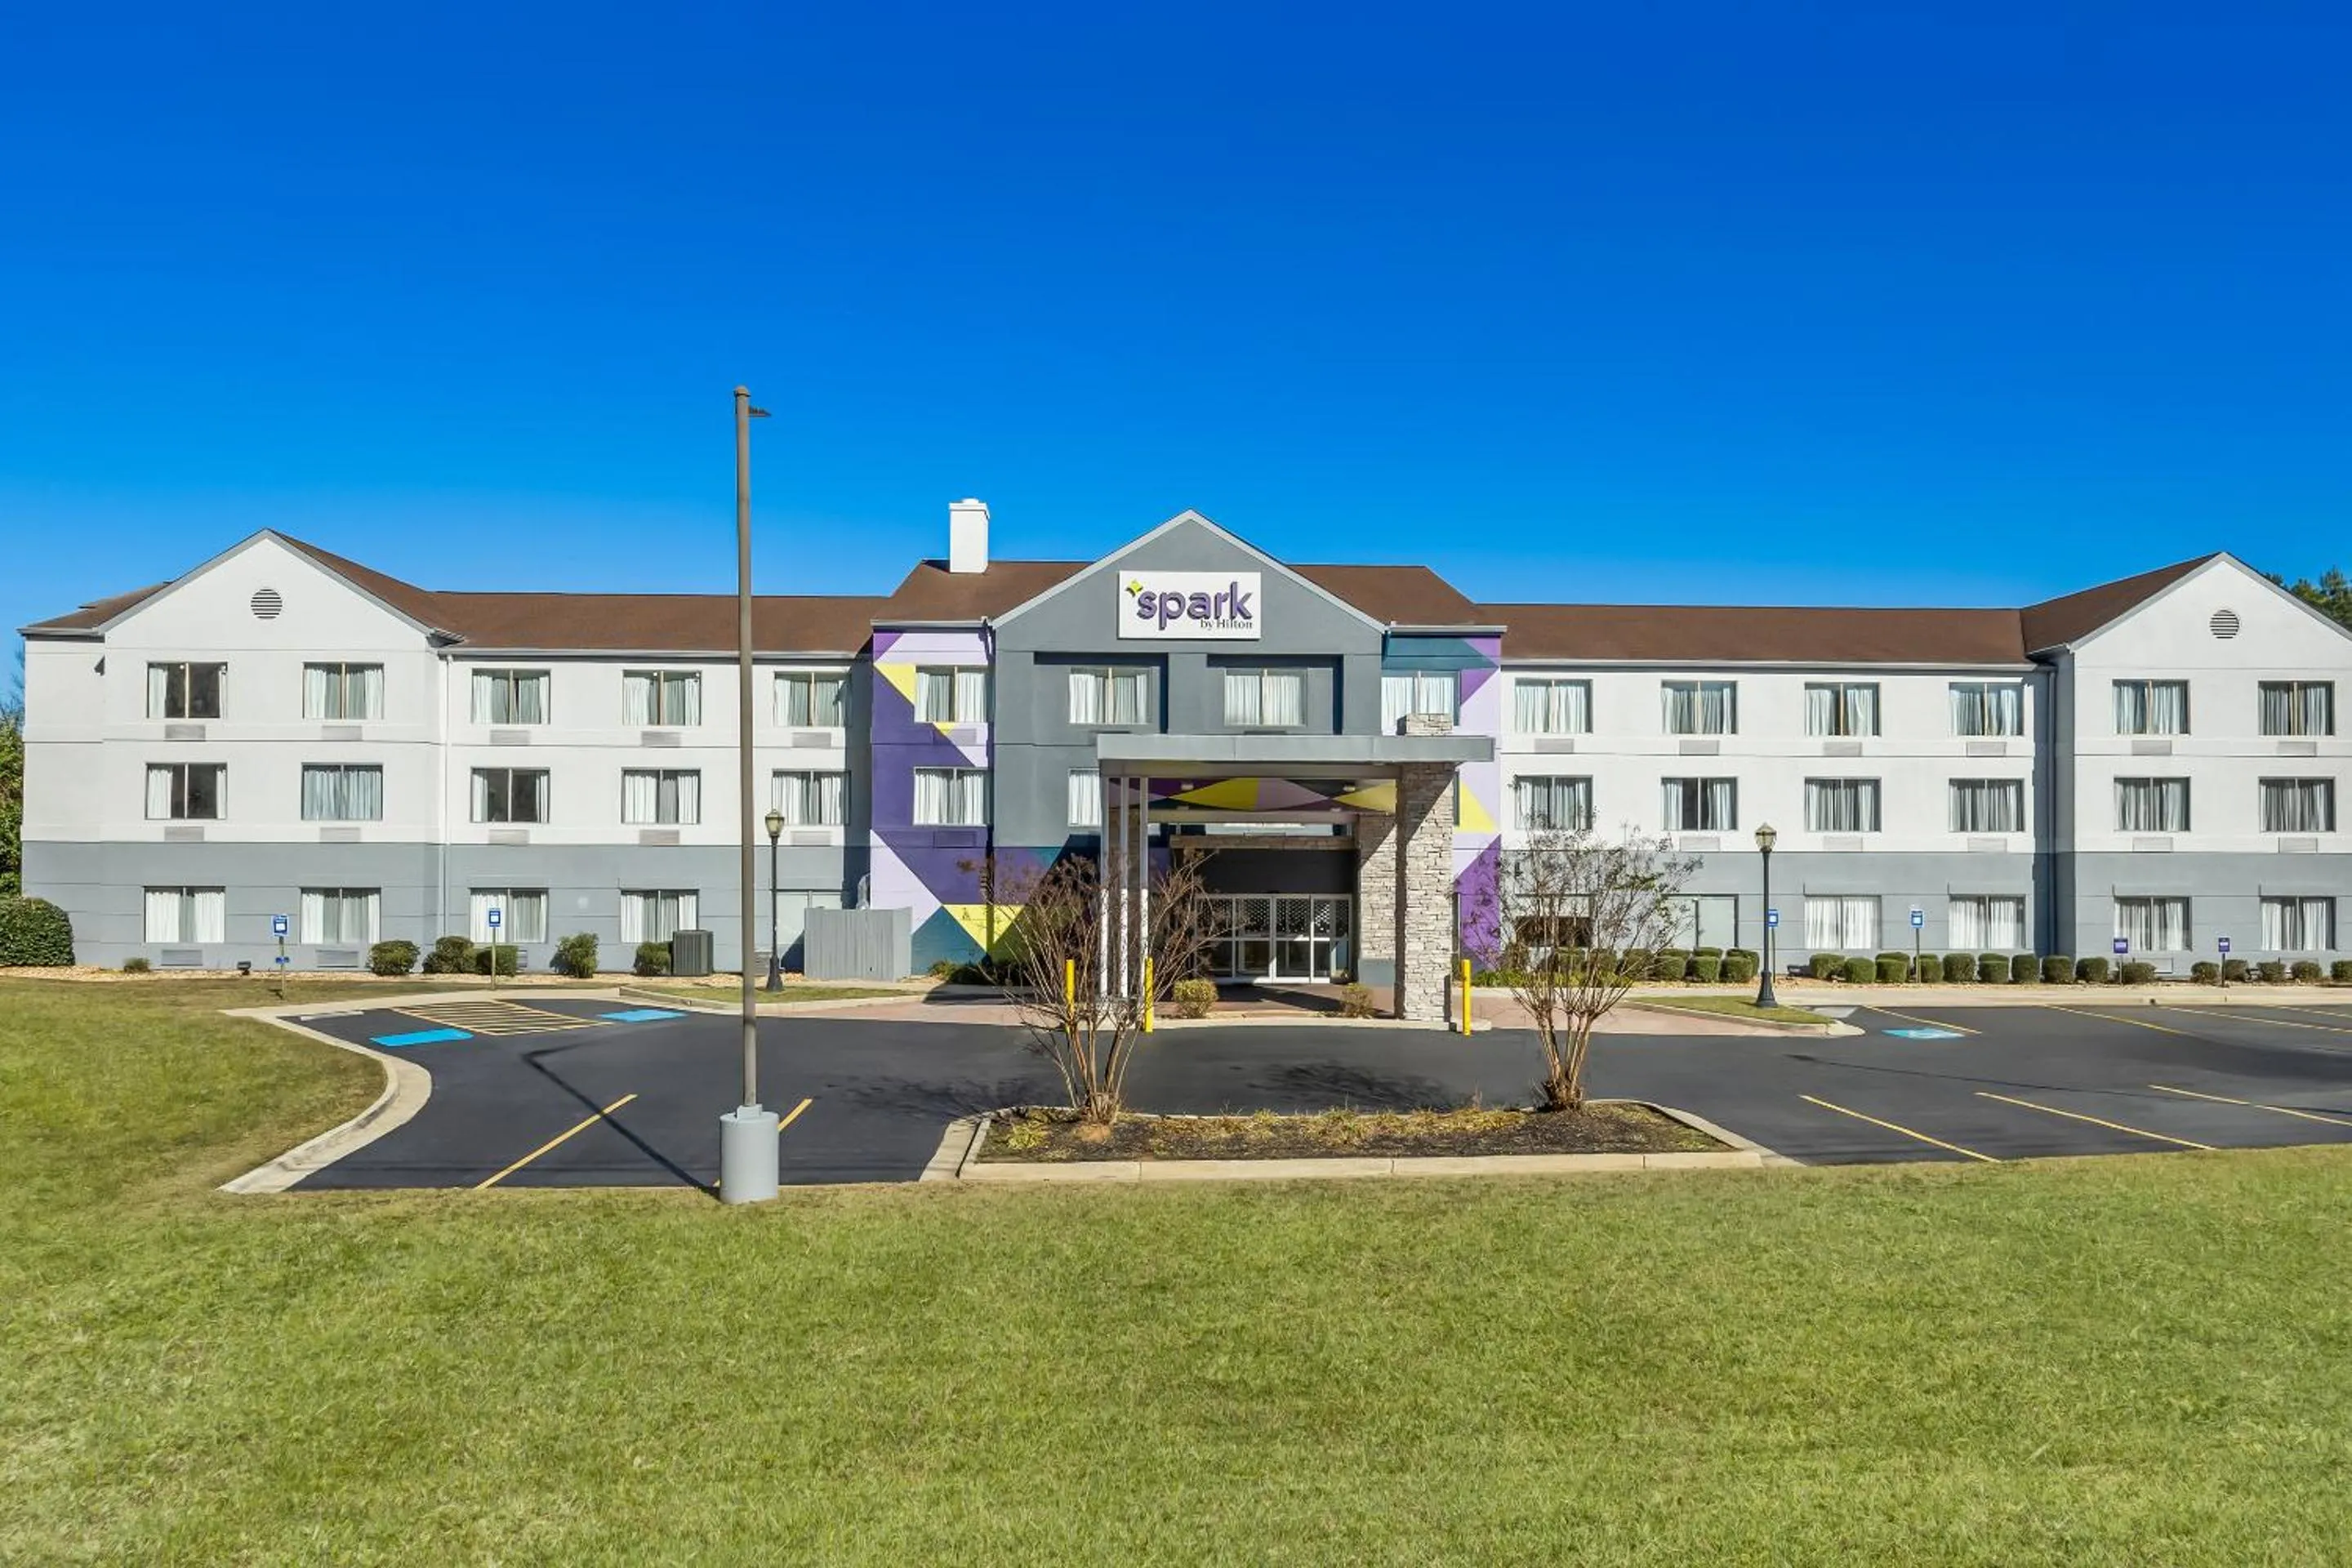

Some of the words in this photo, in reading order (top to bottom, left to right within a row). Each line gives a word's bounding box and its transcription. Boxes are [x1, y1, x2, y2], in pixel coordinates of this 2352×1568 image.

[1137, 581, 1253, 630] spark
[1200, 619, 1214, 630] by
[1217, 619, 1253, 629] Hilton
